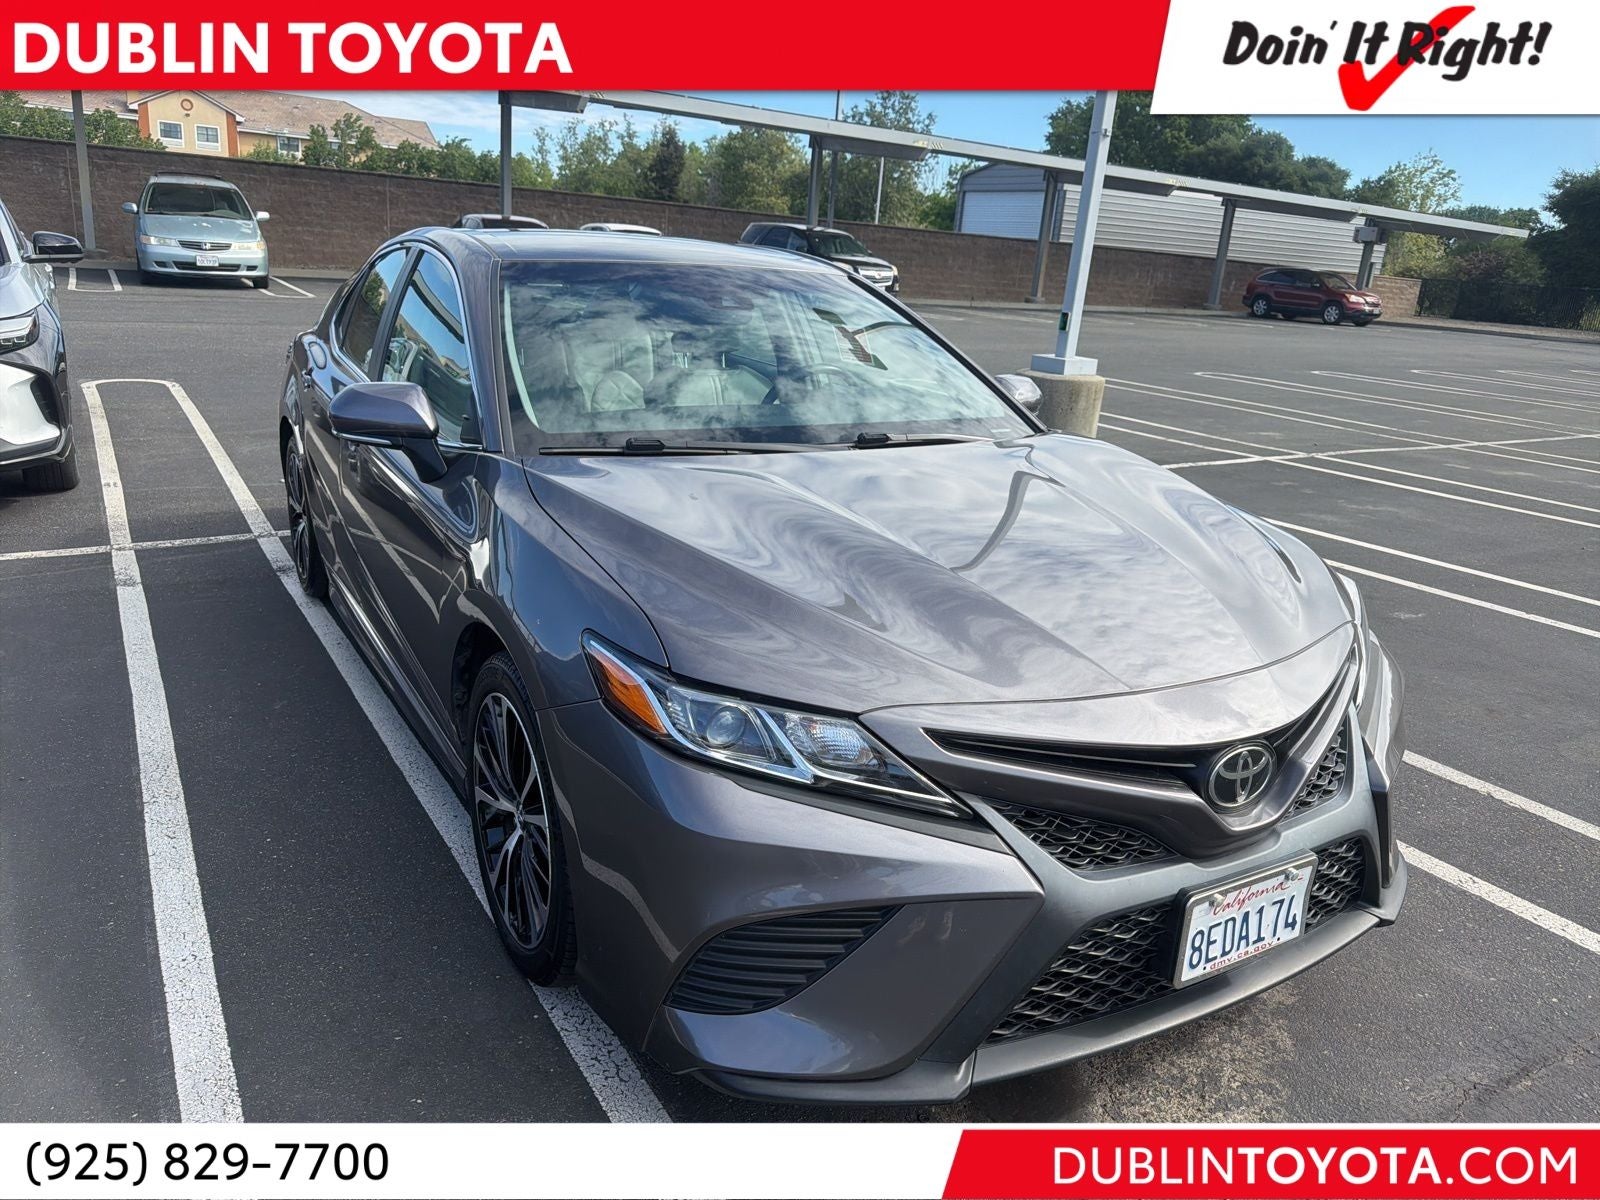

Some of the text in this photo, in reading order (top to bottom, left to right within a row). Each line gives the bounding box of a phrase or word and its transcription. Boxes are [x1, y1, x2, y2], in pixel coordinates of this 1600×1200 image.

[1212, 879, 1290, 916] California
[1188, 894, 1298, 970] 8EDA174
[1209, 941, 1274, 970] dmv.ca.gov
